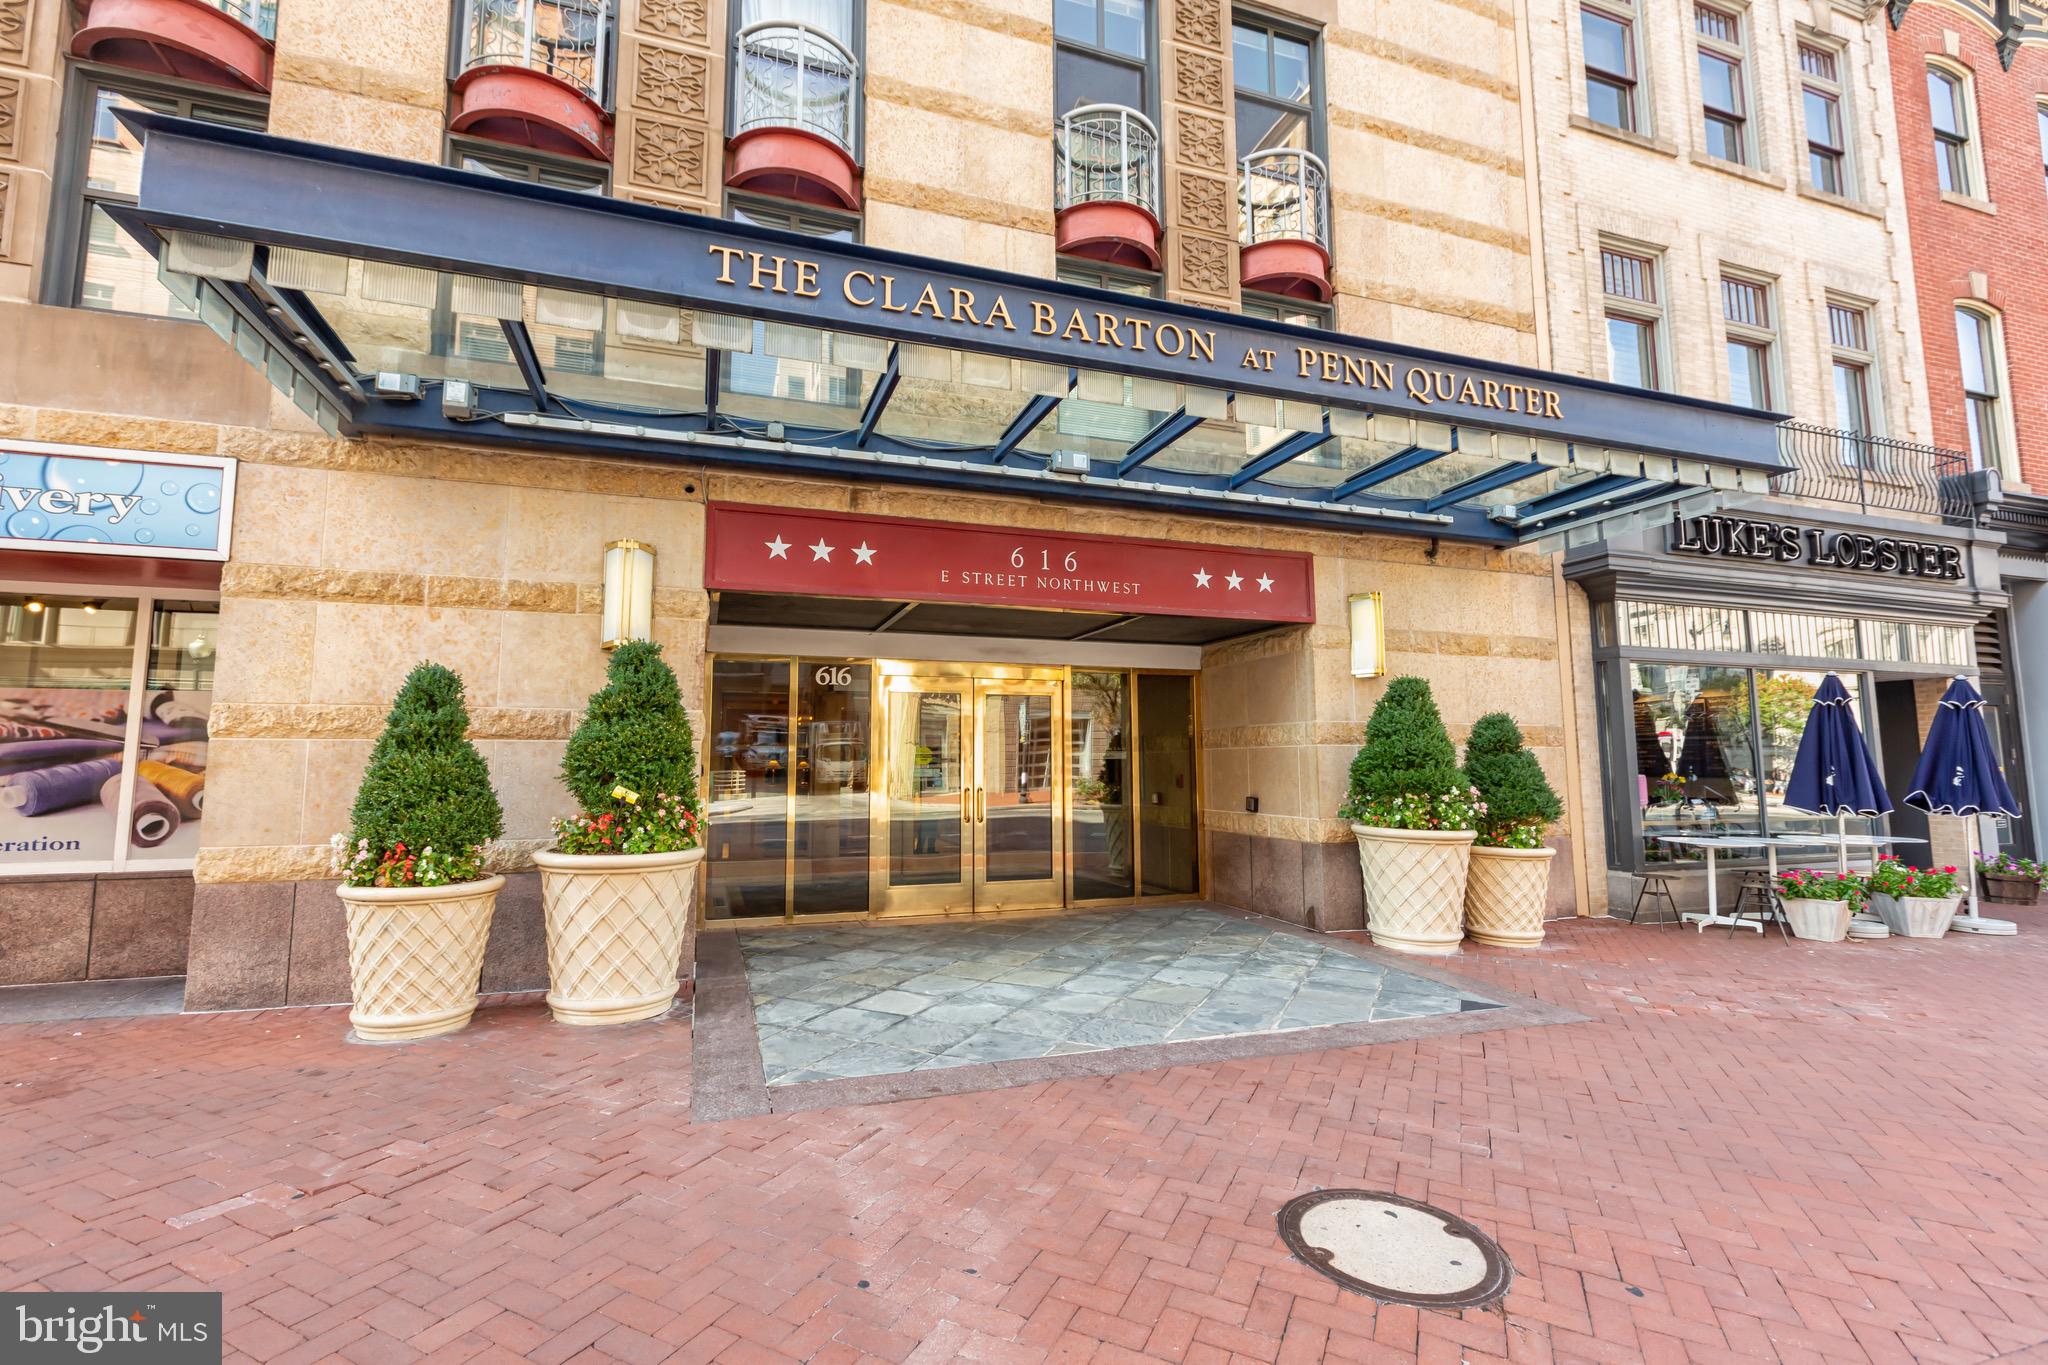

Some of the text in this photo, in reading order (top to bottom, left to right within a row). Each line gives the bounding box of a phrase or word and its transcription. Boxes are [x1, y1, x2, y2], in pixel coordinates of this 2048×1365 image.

[709, 244, 1565, 420] THE CLARA BARTON AT PENN QUARTER
[1671, 511, 1965, 580] LUKE'S LOBSTER
[940, 569, 1141, 596] E STREET NORTHWEST
[815, 665, 852, 687] 616
